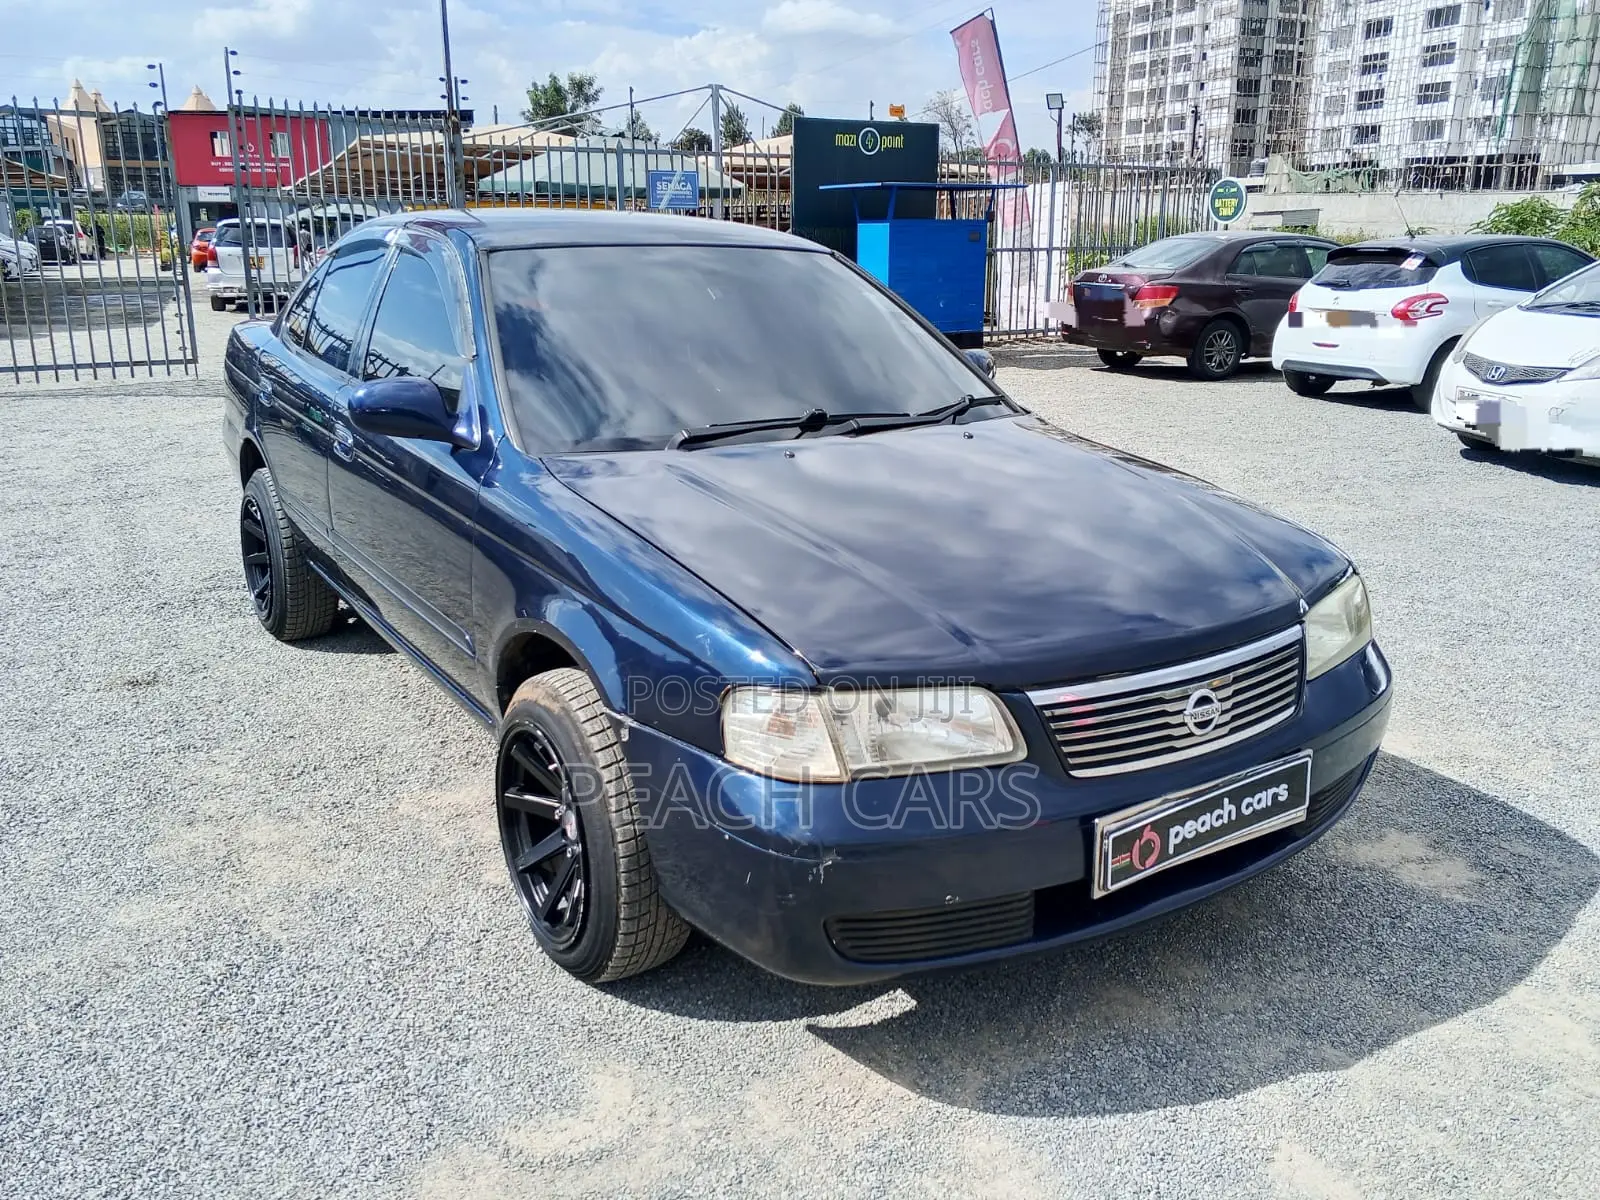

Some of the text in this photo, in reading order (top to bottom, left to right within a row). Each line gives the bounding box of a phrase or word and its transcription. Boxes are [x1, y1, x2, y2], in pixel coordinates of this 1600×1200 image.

[881, 133, 904, 152] point
[1215, 198, 1238, 208] BATTERY
[1219, 207, 1234, 216] SWAP
[1190, 706, 1220, 721] NISSAN
[1167, 783, 1289, 855] peach cars
